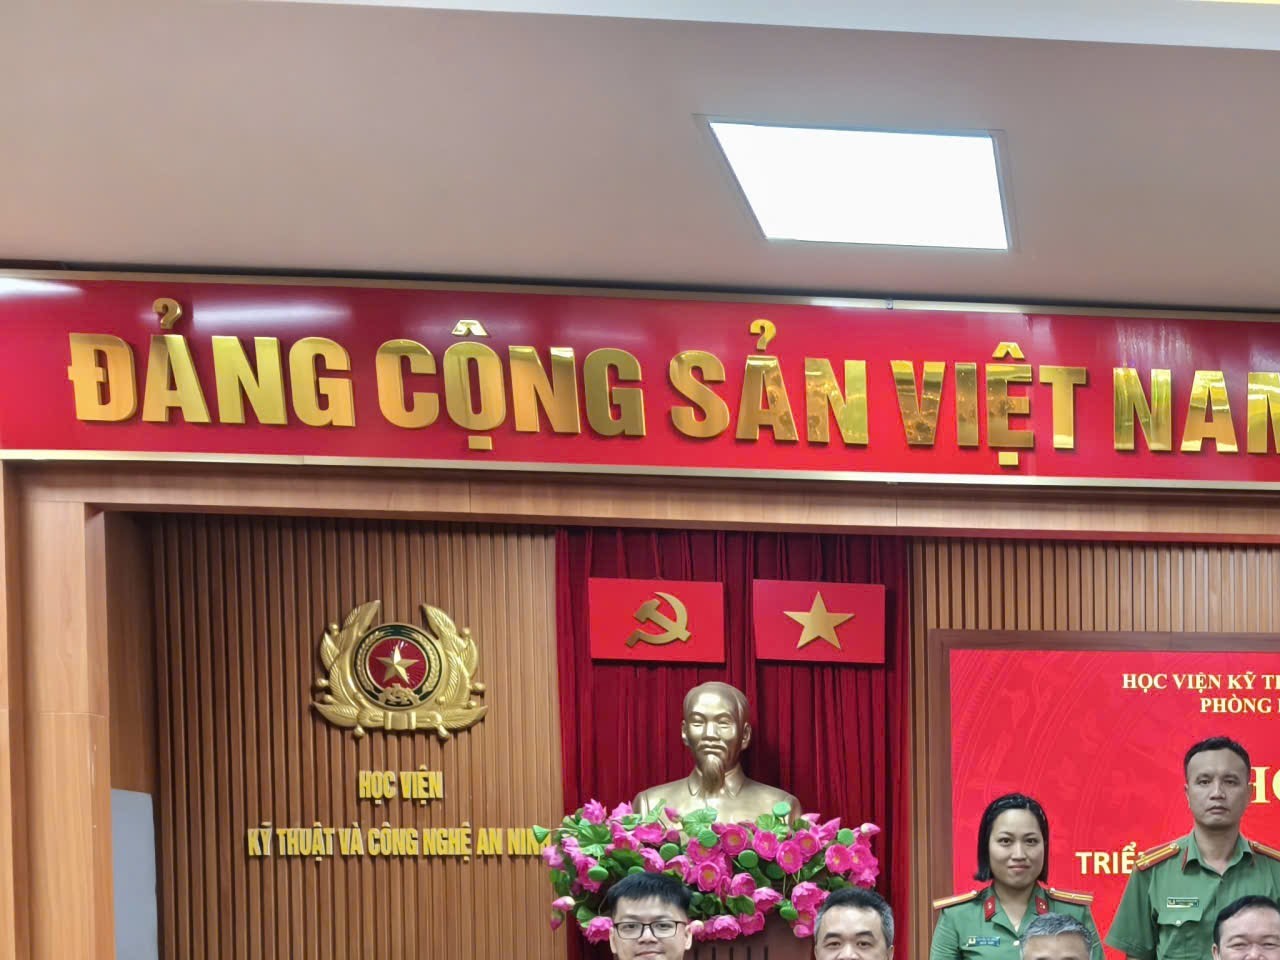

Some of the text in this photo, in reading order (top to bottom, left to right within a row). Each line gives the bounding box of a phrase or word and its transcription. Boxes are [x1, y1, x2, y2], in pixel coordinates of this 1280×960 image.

[68, 298, 354, 427] ĐẢNG
[375, 319, 646, 452] CỘNG
[669, 319, 870, 447] SẢN
[891, 342, 1087, 466] VIỆT
[1122, 673, 1167, 693] HỌC
[1172, 671, 1221, 693] VIỆN
[1228, 671, 1256, 690] KỸ
[1200, 694, 1272, 714] PHÒNG
[359, 764, 444, 805] HỌC VIỆN
[248, 821, 273, 856] KỸ
[276, 821, 335, 861] THUẬT
[339, 822, 364, 856] VÀ
[367, 821, 419, 856] CÔNG
[423, 821, 473, 861] NGHỆ
[476, 828, 503, 855] AN
[1075, 841, 1144, 874] TRIỂ
